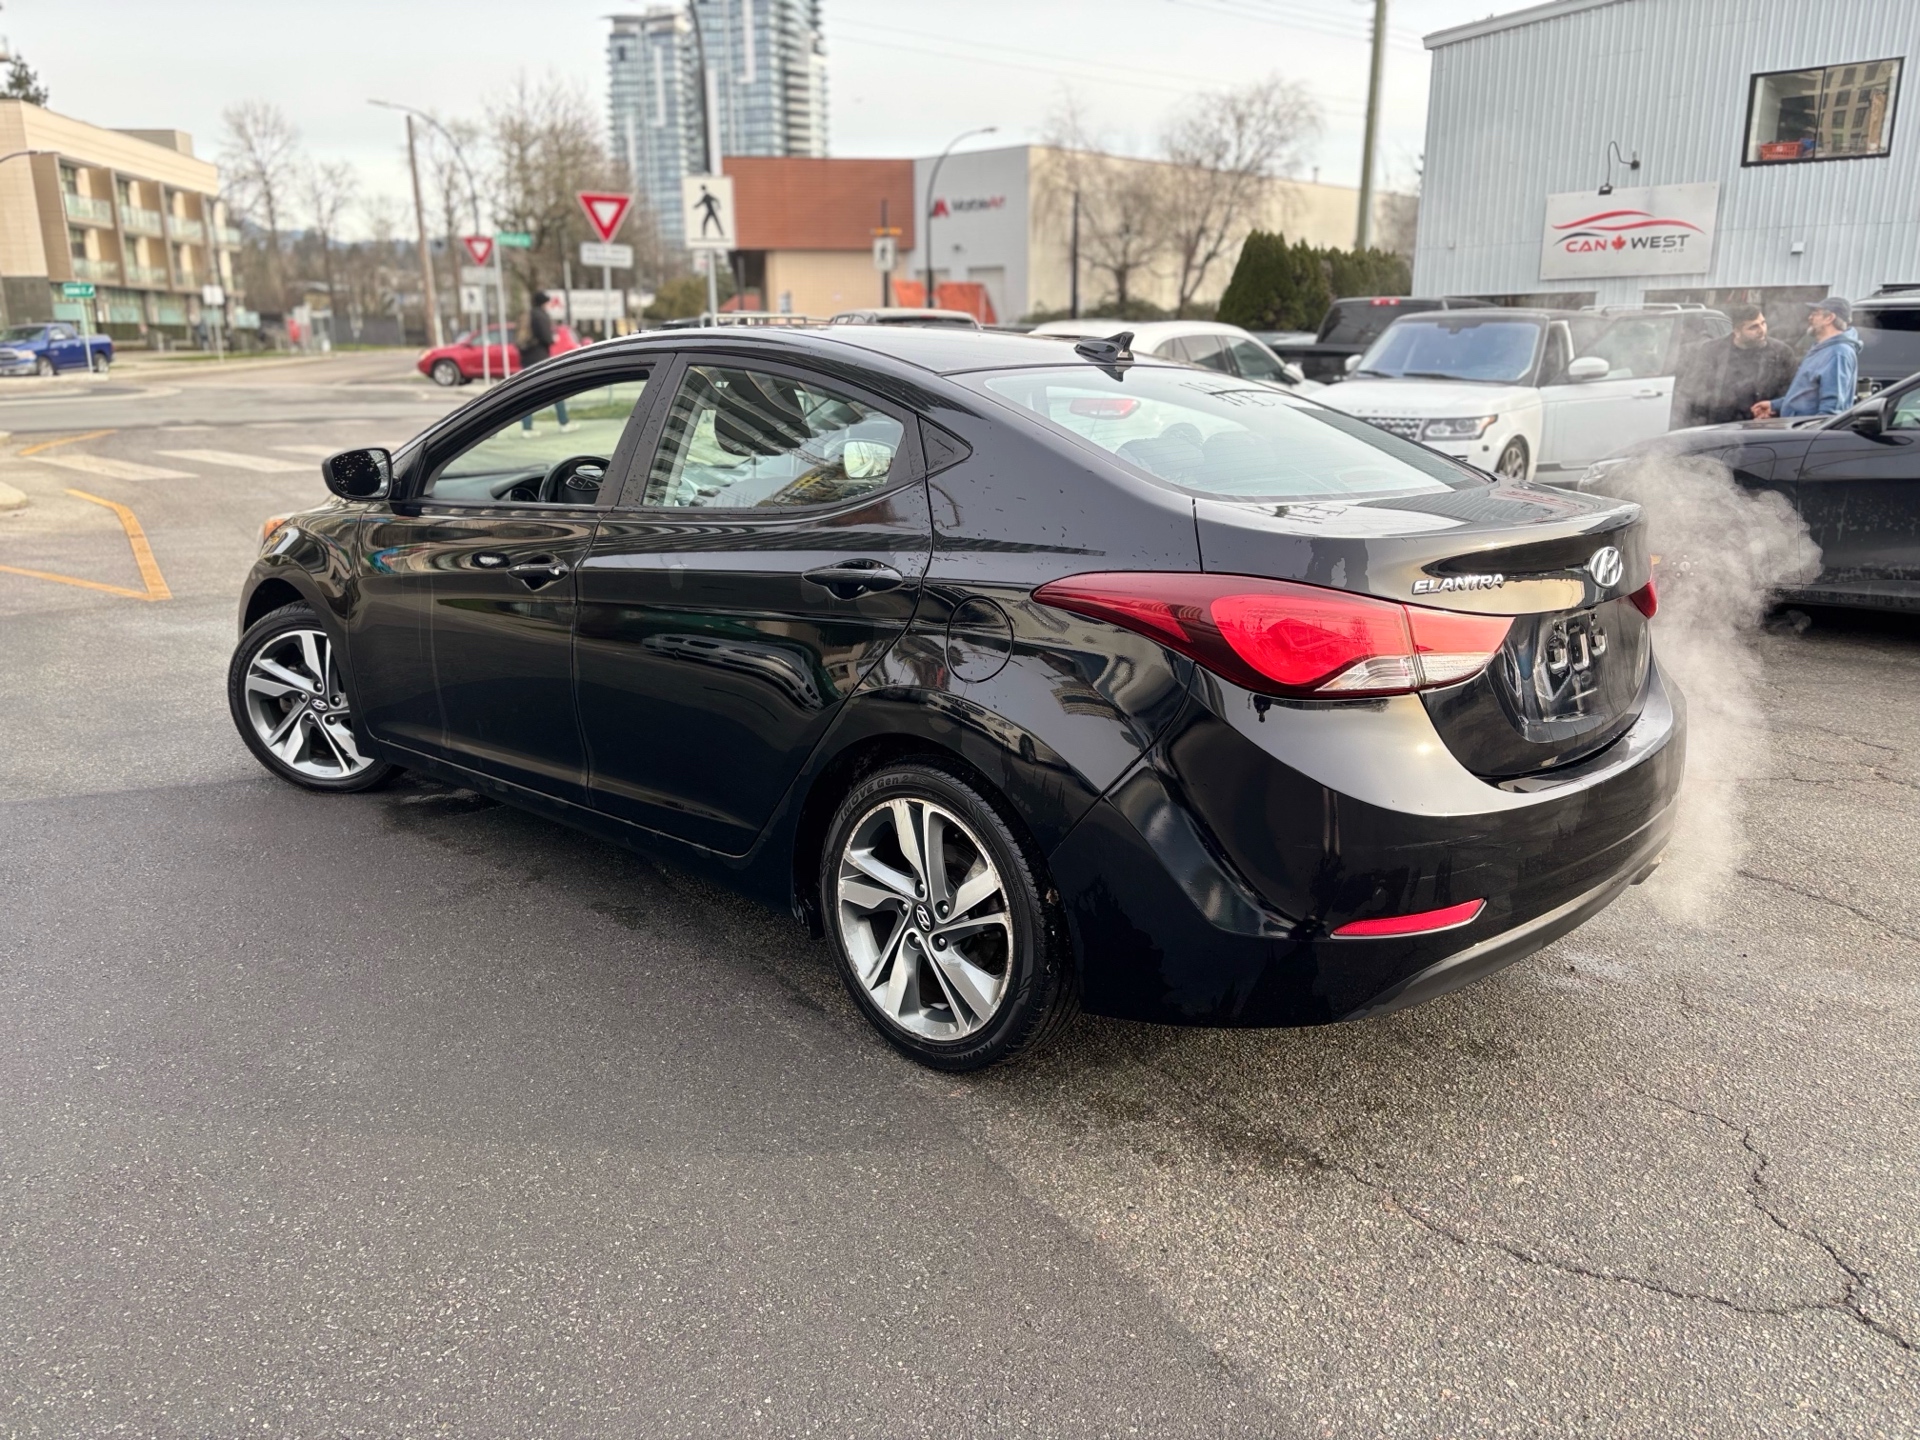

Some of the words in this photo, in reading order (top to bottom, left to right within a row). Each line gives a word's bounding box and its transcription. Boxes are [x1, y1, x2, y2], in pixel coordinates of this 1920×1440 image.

[1566, 240, 1607, 252] CAN
[1631, 234, 1690, 249] WEST
[1412, 573, 1504, 595] ELANTRA
[877, 777, 898, 788] Gen
